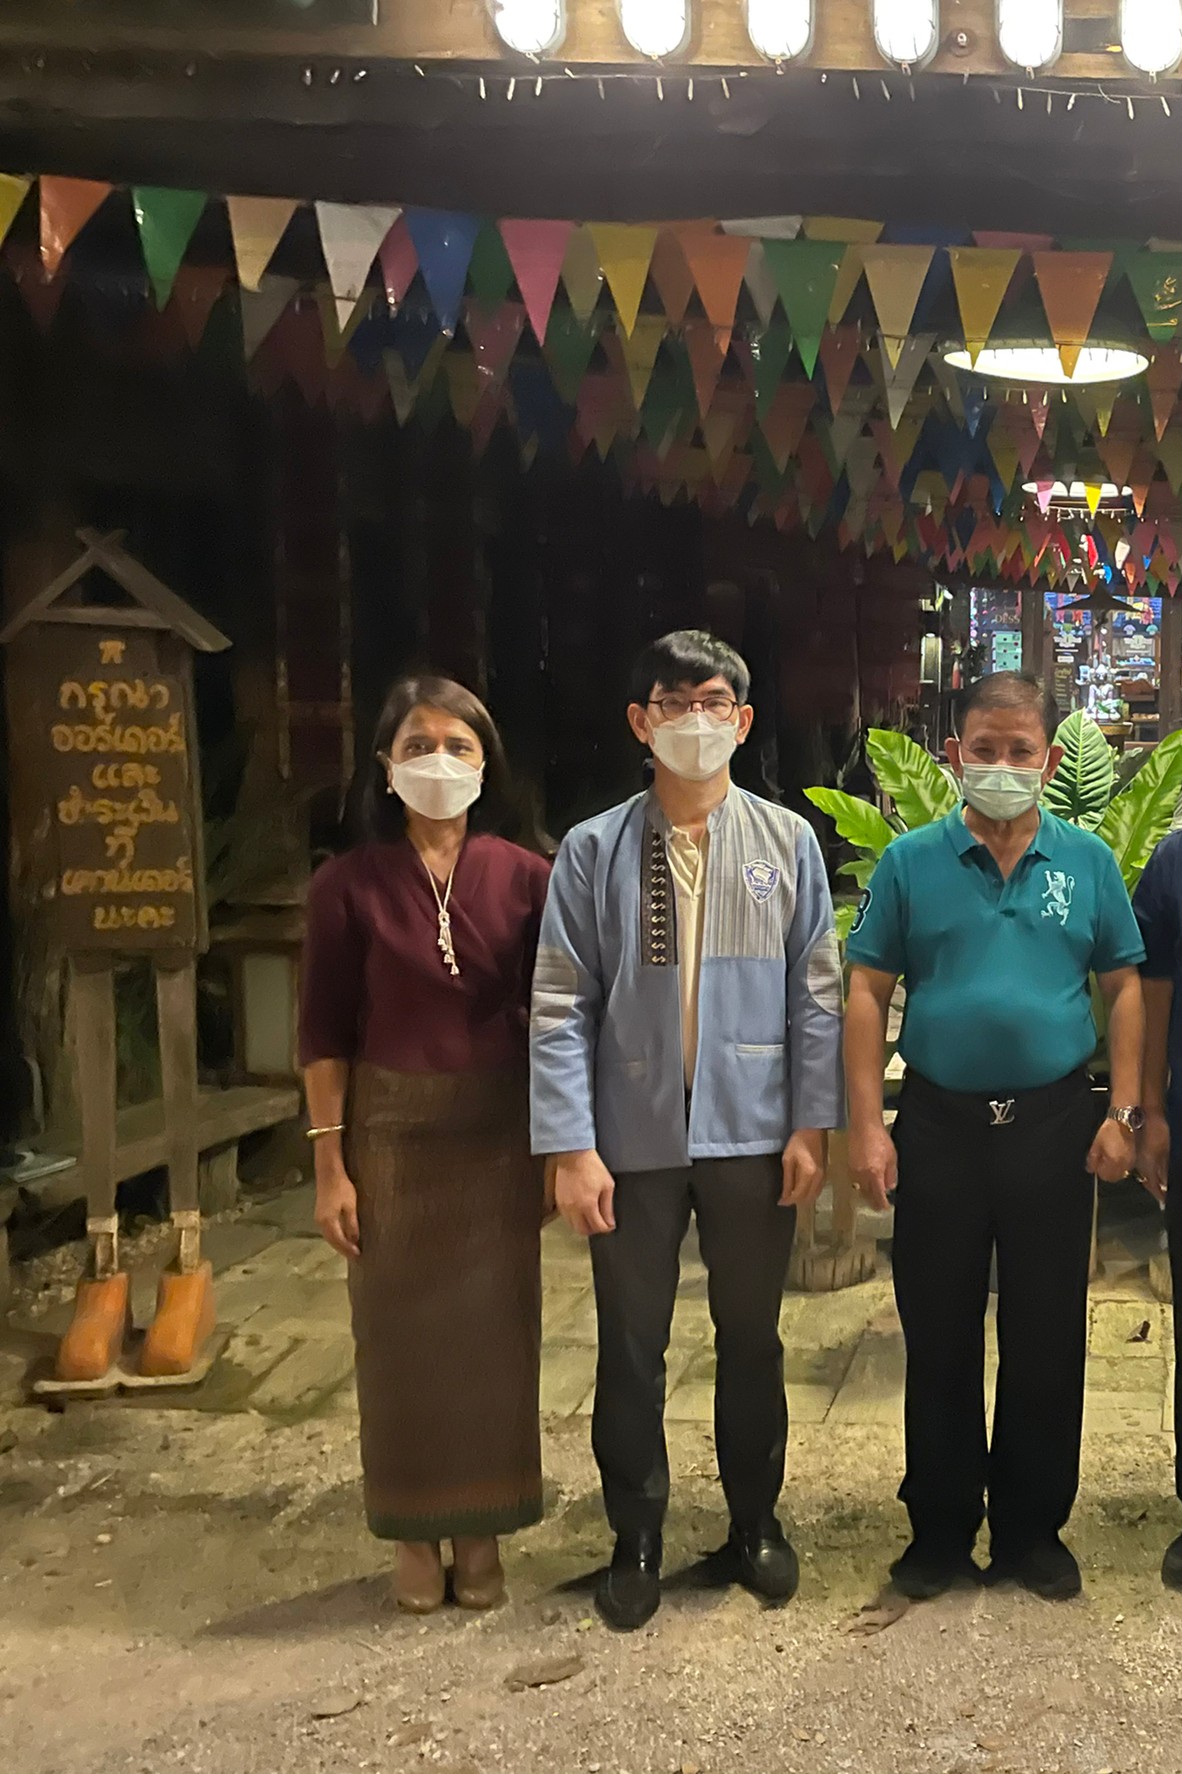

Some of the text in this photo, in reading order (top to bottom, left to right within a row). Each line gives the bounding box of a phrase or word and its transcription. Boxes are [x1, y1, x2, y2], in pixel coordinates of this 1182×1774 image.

[60, 679, 169, 722] กรุณา
[92, 763, 161, 789] และ
[58, 785, 178, 825] ชำระเงิน
[105, 821, 138, 869] ที่
[94, 905, 175, 930] นะคะ
